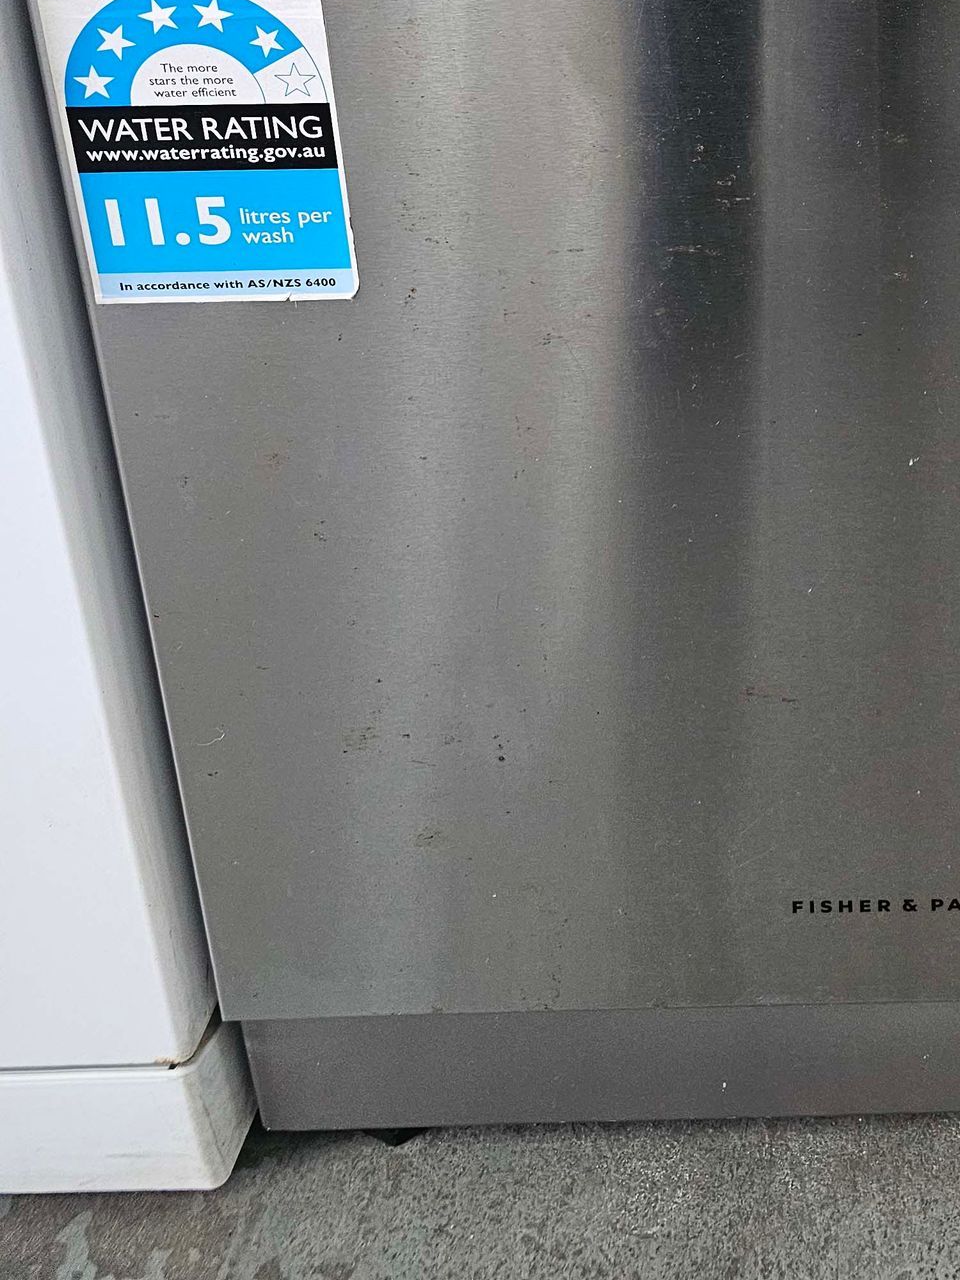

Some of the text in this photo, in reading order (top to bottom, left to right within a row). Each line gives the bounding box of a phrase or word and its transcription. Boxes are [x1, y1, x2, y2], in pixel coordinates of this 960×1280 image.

[159, 63, 218, 73] The more
[149, 75, 234, 86] stars the more
[154, 87, 237, 98] water efficient
[78, 116, 323, 142] WATER RATING
[86, 144, 326, 163] www.waterrating.gov.au
[104, 196, 332, 247] 11.5 litres per
[242, 226, 294, 245] wash
[120, 277, 337, 291] In accordance with AS/NZS 6400
[792, 899, 891, 914] FISHER
[902, 898, 918, 912] &
